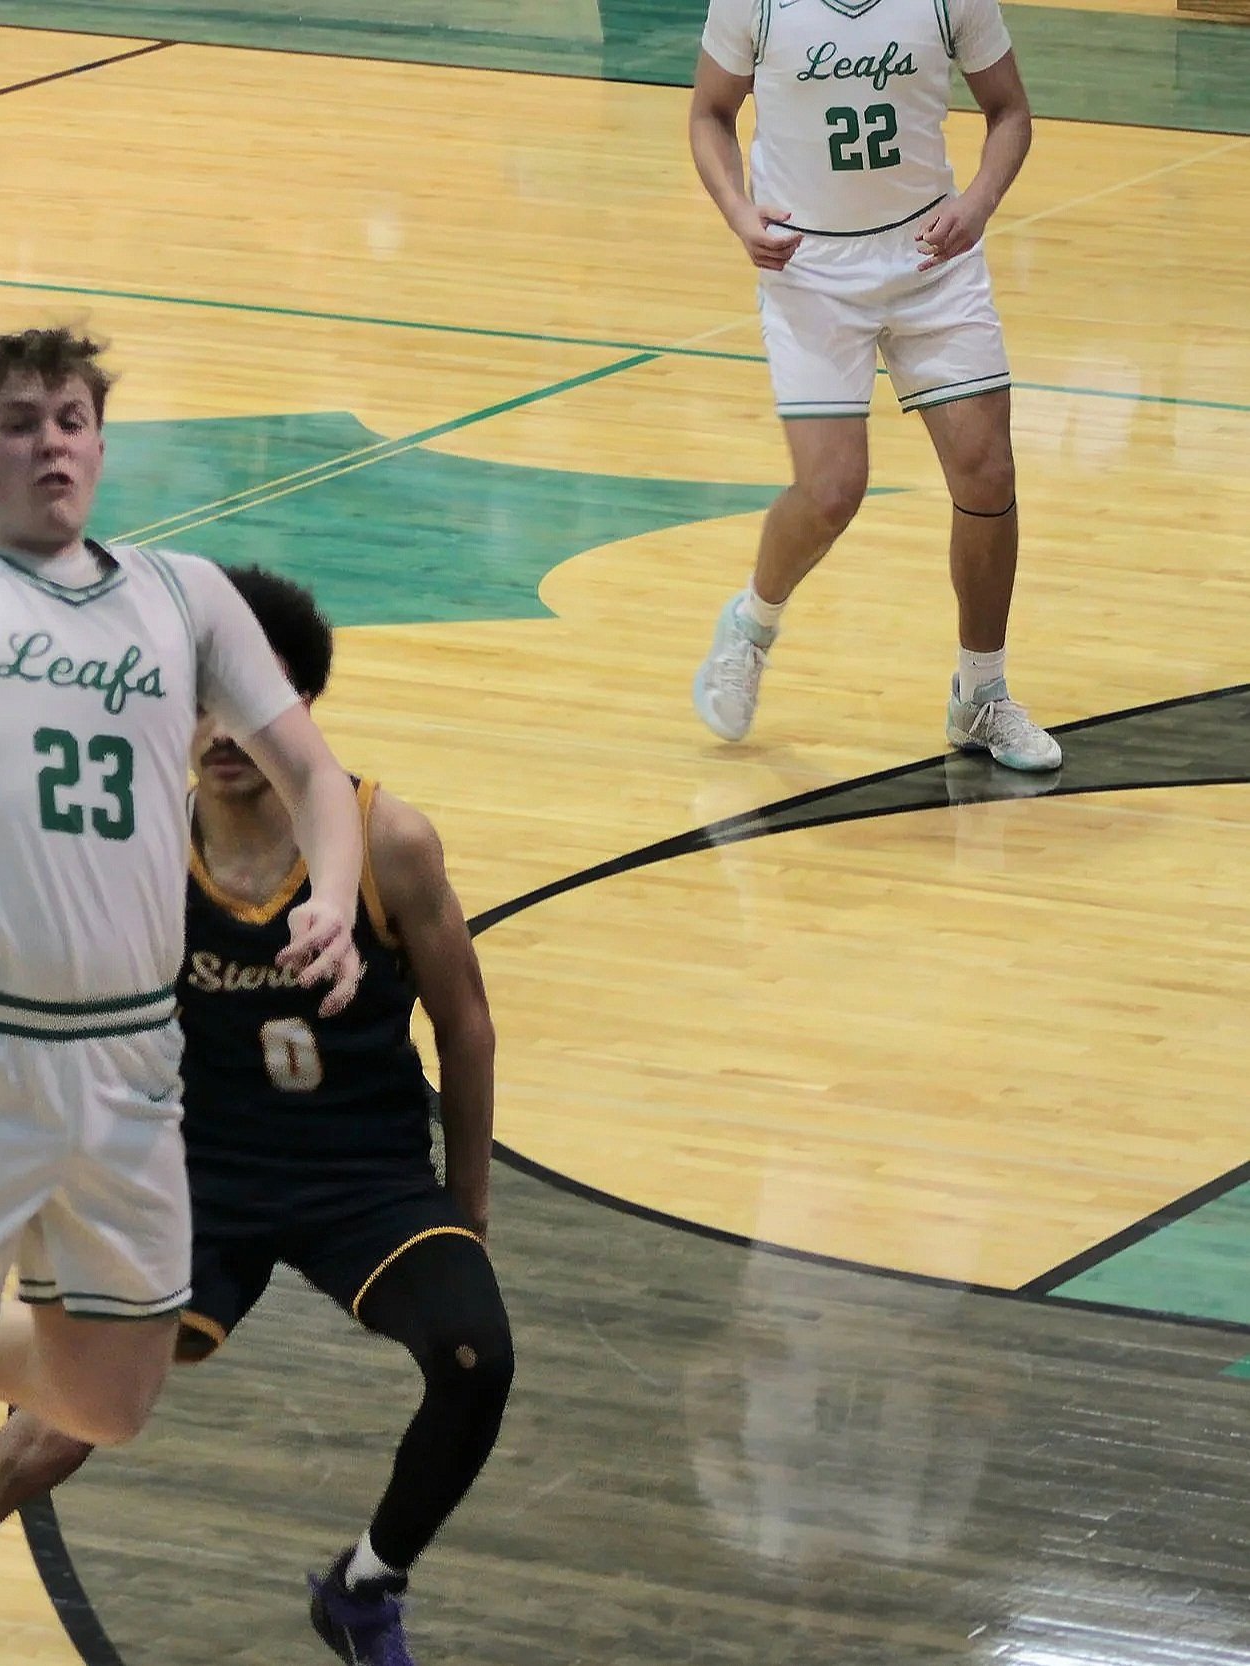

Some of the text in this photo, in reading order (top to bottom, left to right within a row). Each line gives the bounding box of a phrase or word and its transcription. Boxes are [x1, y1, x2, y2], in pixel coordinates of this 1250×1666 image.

[796, 41, 918, 91] Leafs
[825, 103, 901, 171] 22
[33, 727, 135, 841] 23
[259, 1017, 325, 1093] 0
